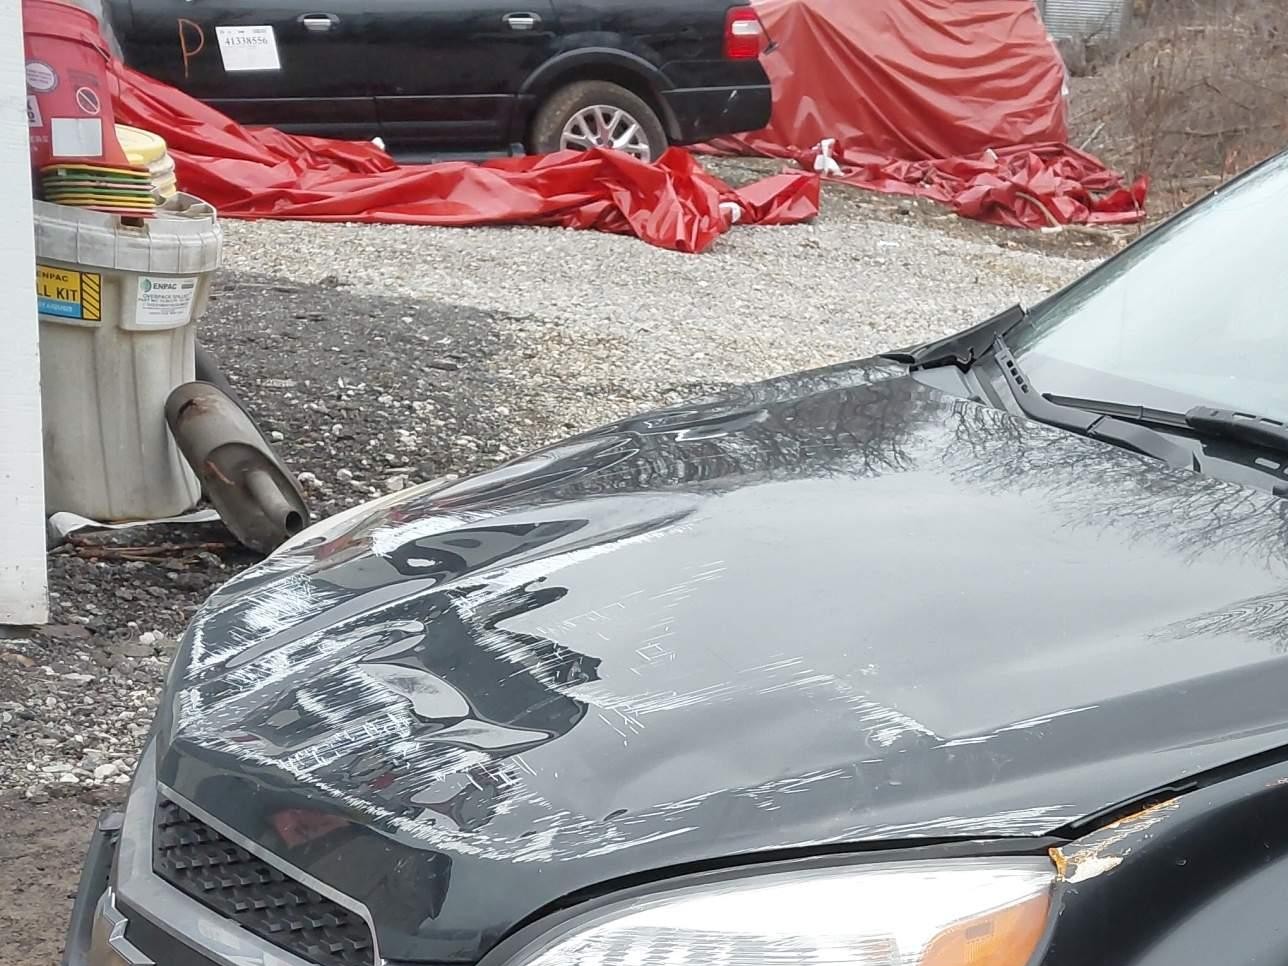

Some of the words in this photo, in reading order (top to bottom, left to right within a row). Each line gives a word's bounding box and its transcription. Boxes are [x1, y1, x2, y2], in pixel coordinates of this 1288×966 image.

[178, 18, 204, 78] P
[153, 282, 177, 290] ENPAC
[56, 287, 78, 301] KIT
